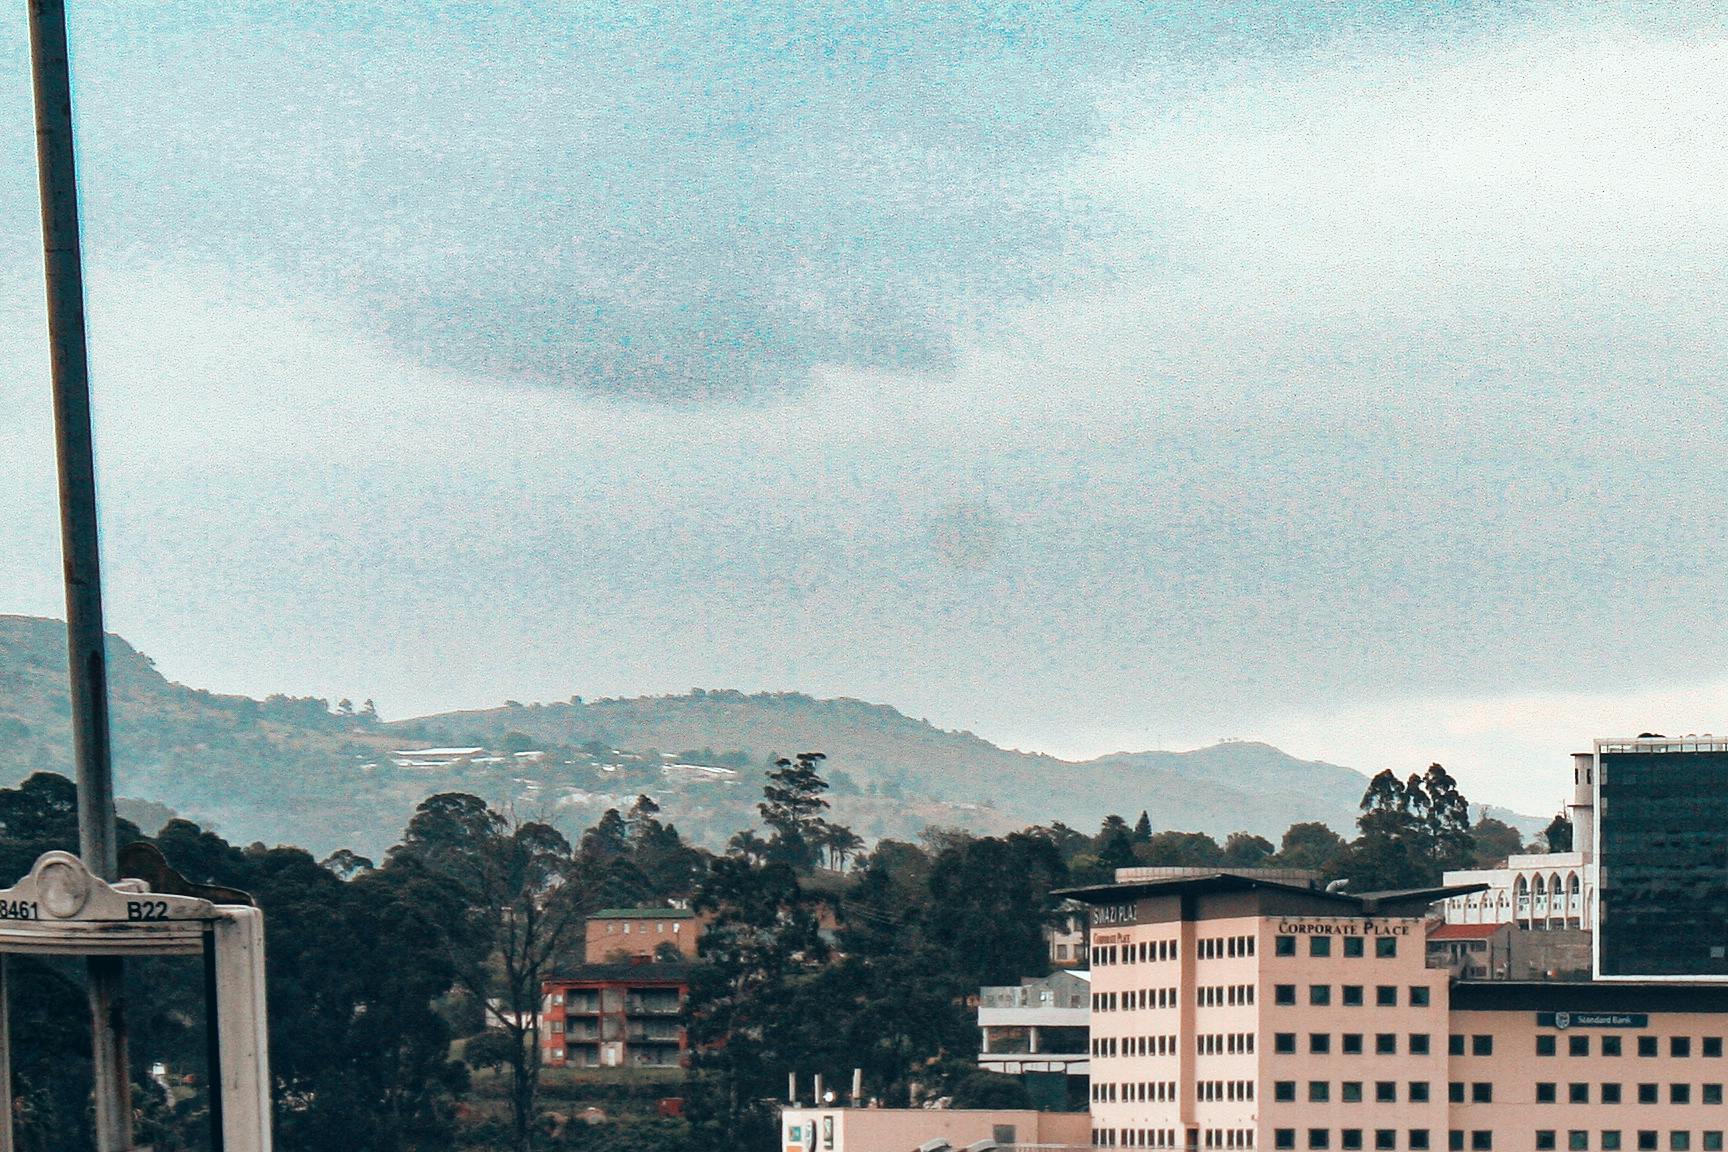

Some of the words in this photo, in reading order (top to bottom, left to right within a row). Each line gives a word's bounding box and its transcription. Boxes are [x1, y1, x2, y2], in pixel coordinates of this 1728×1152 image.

[127, 902, 168, 920] B22
[1279, 922, 1357, 935] CORPORATE
[1364, 922, 1409, 935] PLACE
[1578, 1015, 1611, 1024] Standard
[1613, 1015, 1632, 1024] Bank
